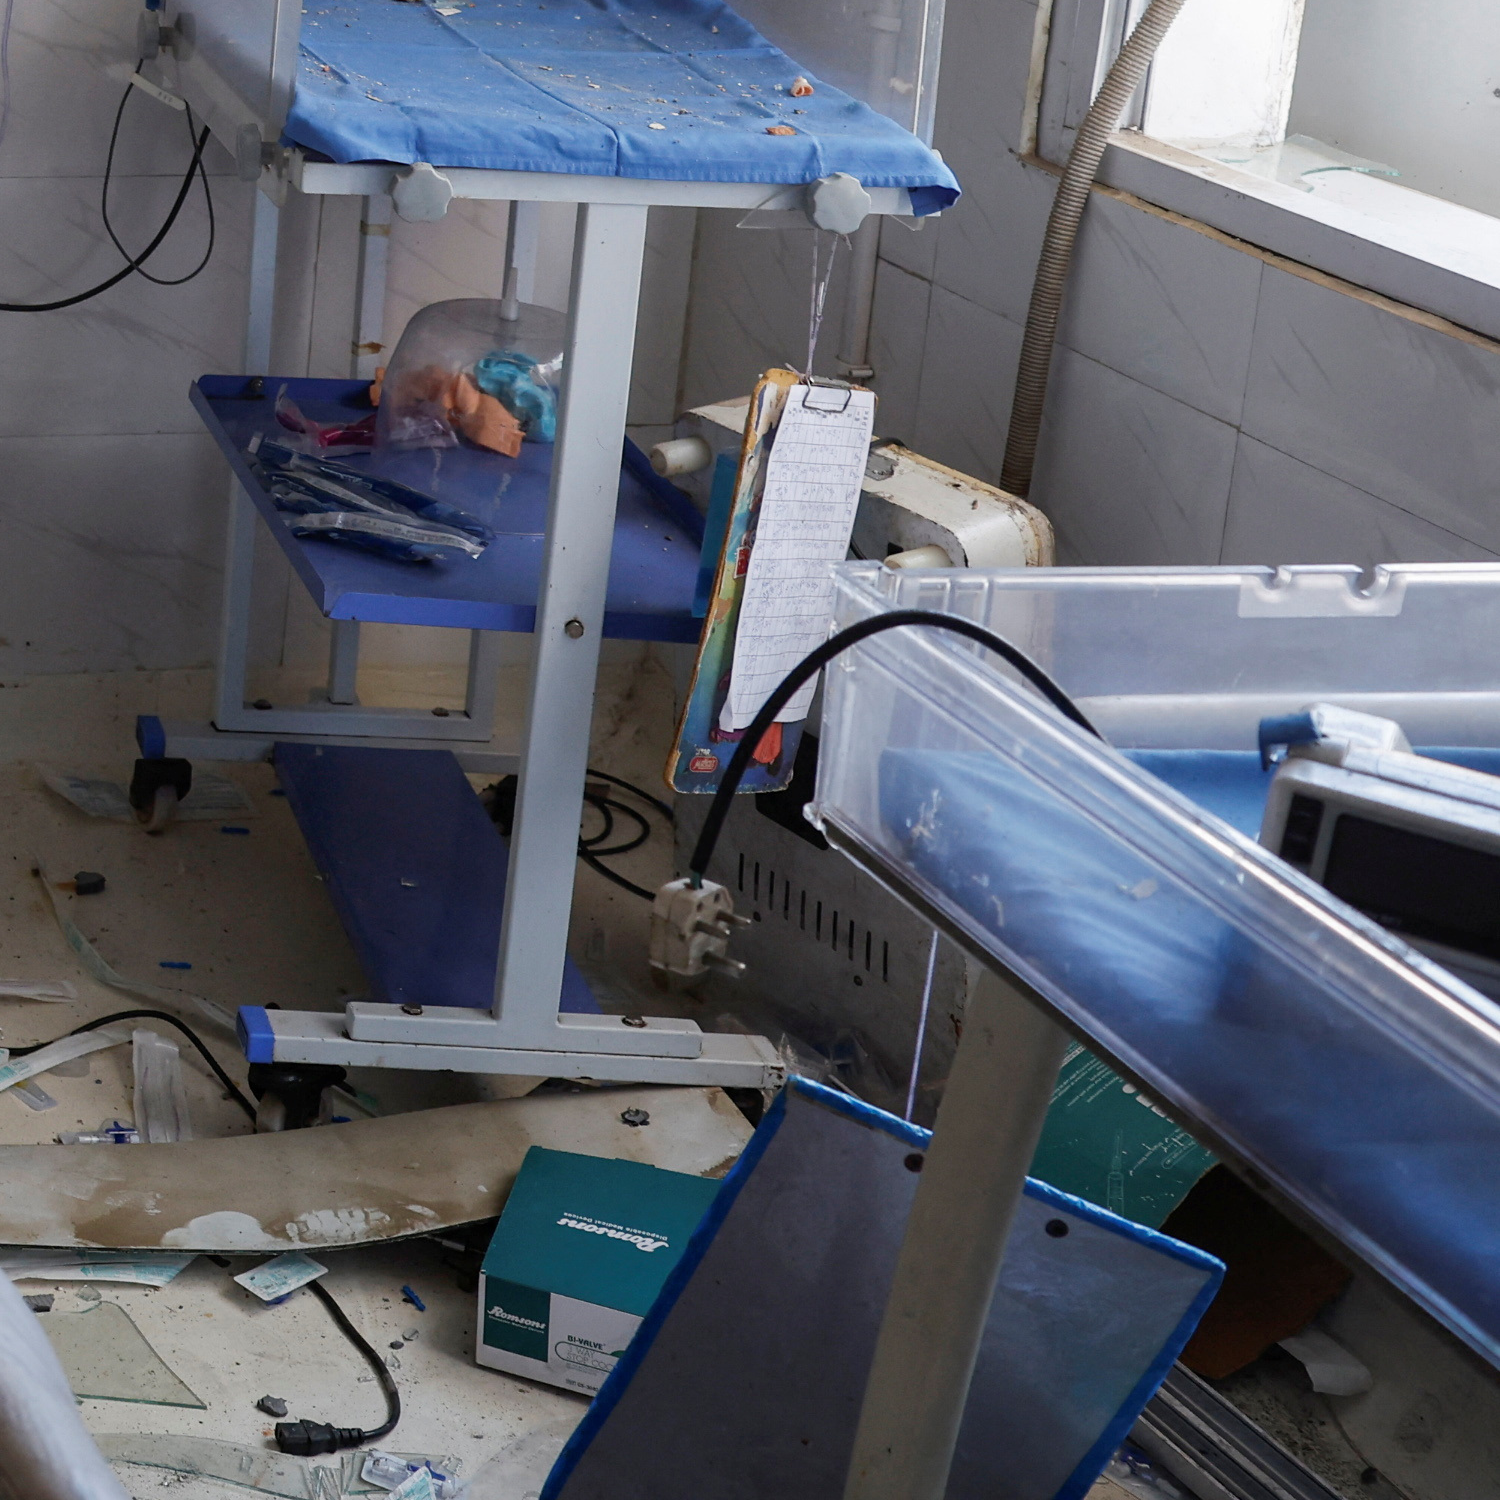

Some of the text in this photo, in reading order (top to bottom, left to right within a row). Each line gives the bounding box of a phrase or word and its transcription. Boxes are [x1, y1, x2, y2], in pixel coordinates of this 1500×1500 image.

[556, 1217, 670, 1253] Romsons
[563, 1212, 668, 1241] Disposable Medical Devices
[487, 1305, 546, 1330] Romsons
[567, 1335, 603, 1351] BI-VALVE
